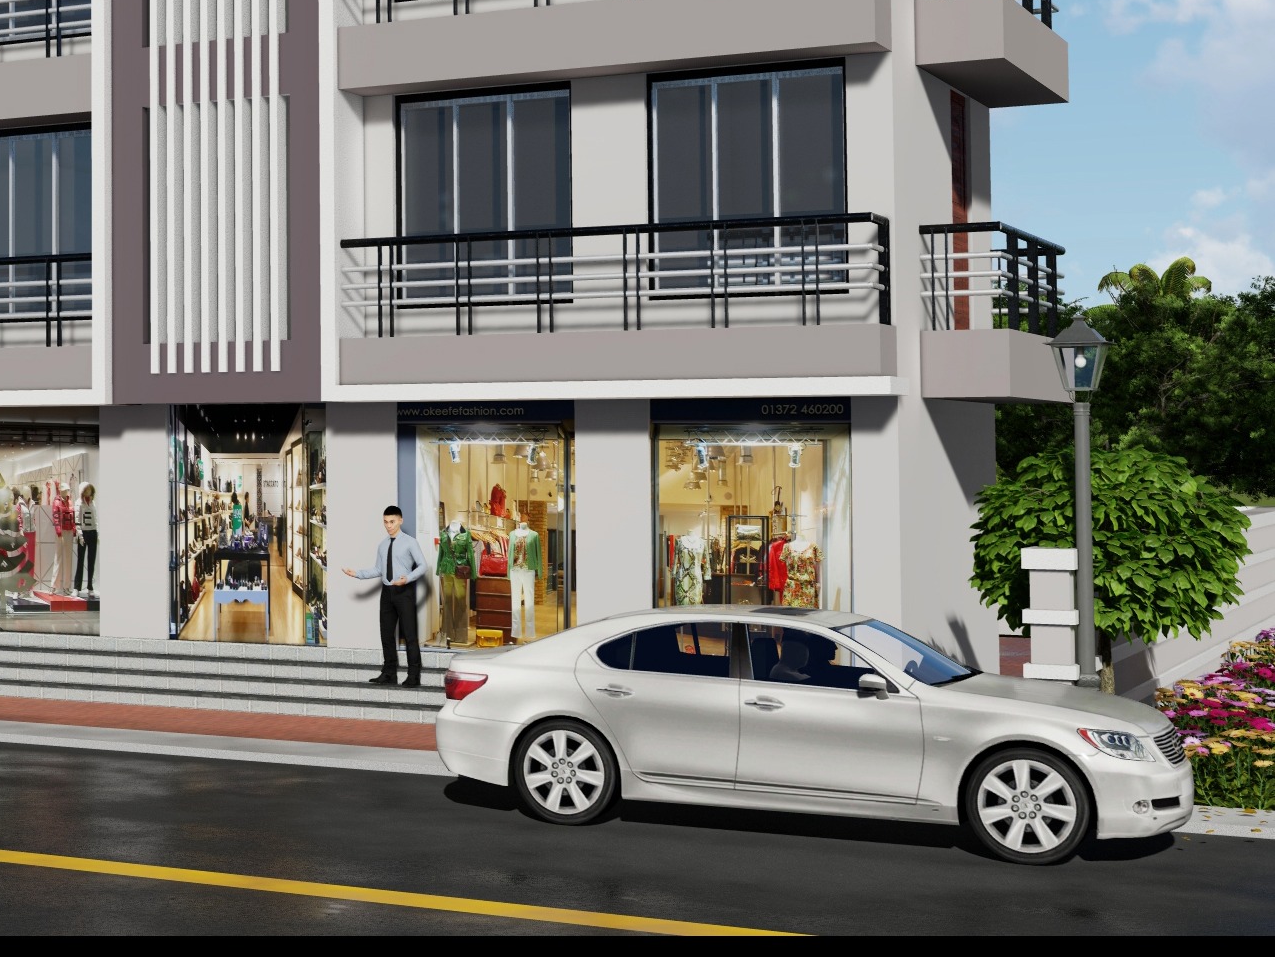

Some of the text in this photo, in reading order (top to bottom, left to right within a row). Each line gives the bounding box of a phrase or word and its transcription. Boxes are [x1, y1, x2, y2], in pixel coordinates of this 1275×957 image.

[397, 406, 524, 417] www.okeefefashion.com
[761, 404, 844, 415] 01372 460200
